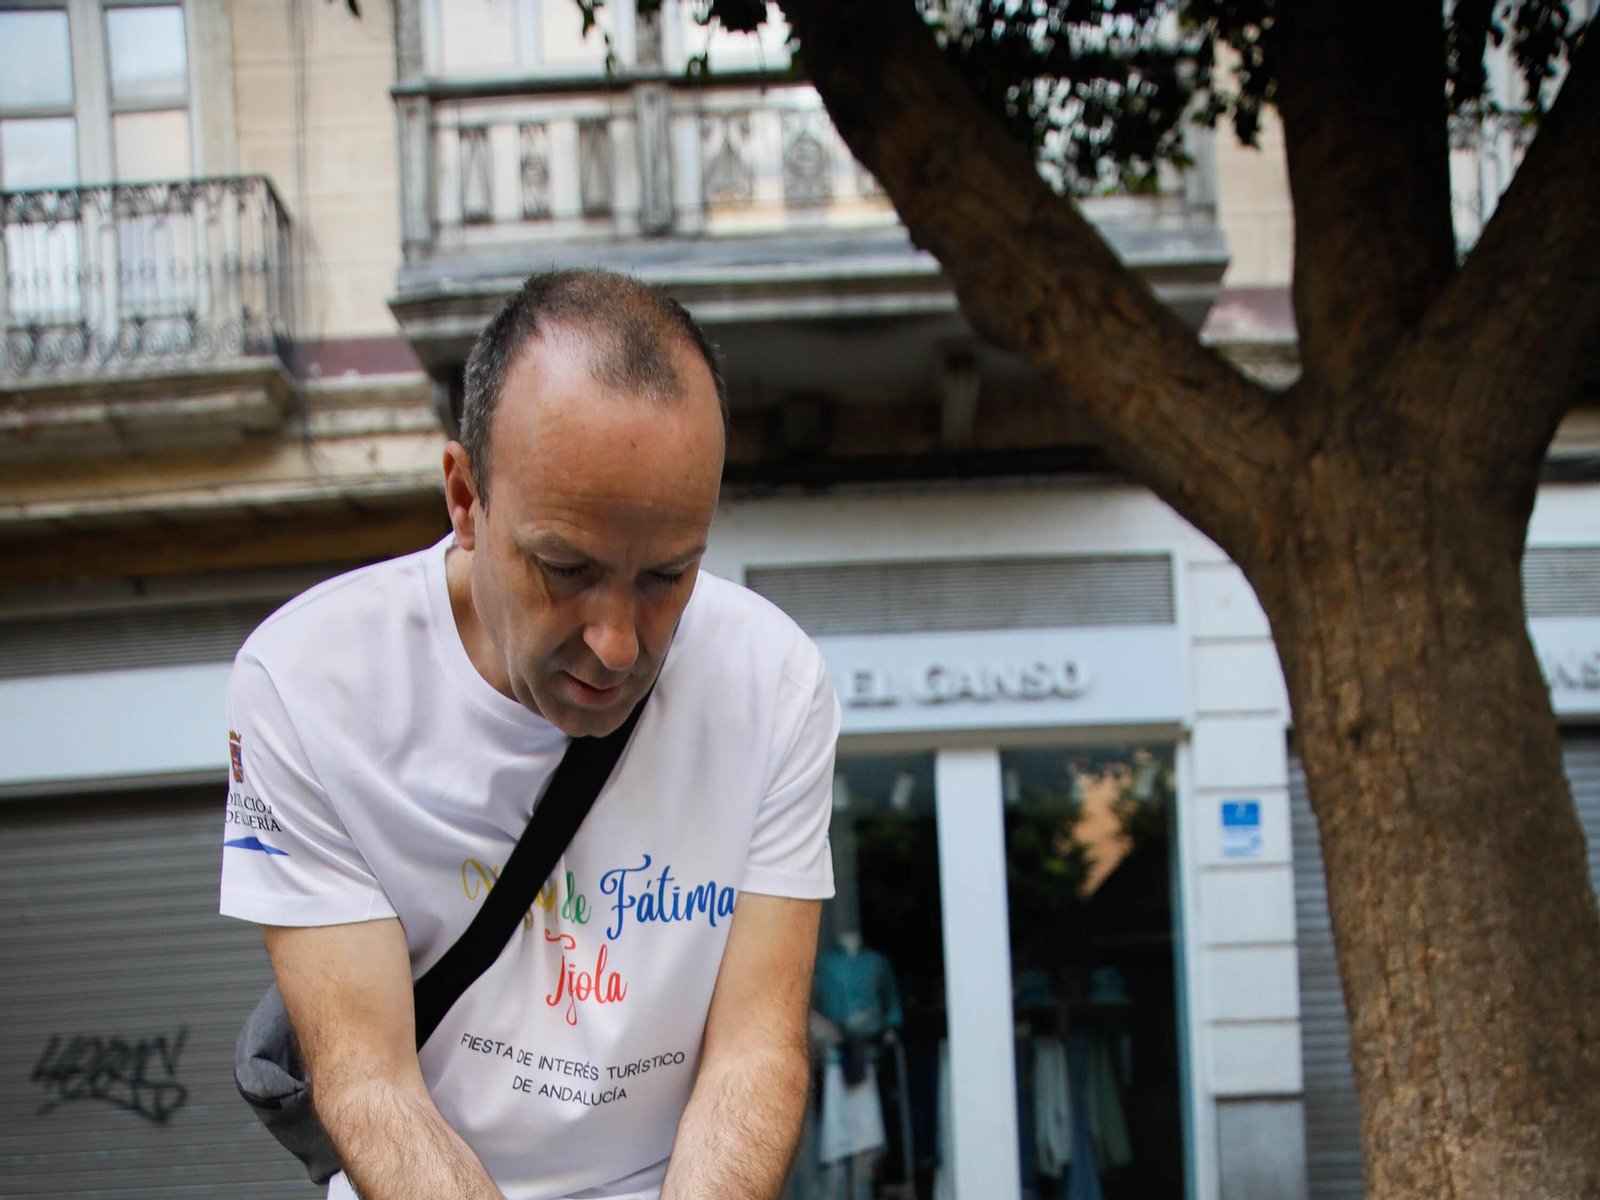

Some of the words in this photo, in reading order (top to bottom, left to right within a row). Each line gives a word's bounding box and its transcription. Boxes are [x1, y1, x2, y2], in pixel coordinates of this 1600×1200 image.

[846, 666, 898, 707] EL
[912, 657, 1088, 704] GANSO
[561, 870, 592, 924] de
[599, 853, 735, 940] Fátima
[460, 1033, 513, 1060] FIESTA
[516, 1049, 534, 1067] DE
[538, 1055, 599, 1081] INTERÉS
[606, 1051, 685, 1080] TURÍSTICO
[512, 1075, 533, 1093] DE
[538, 1084, 627, 1106] ANDALUCÍA
